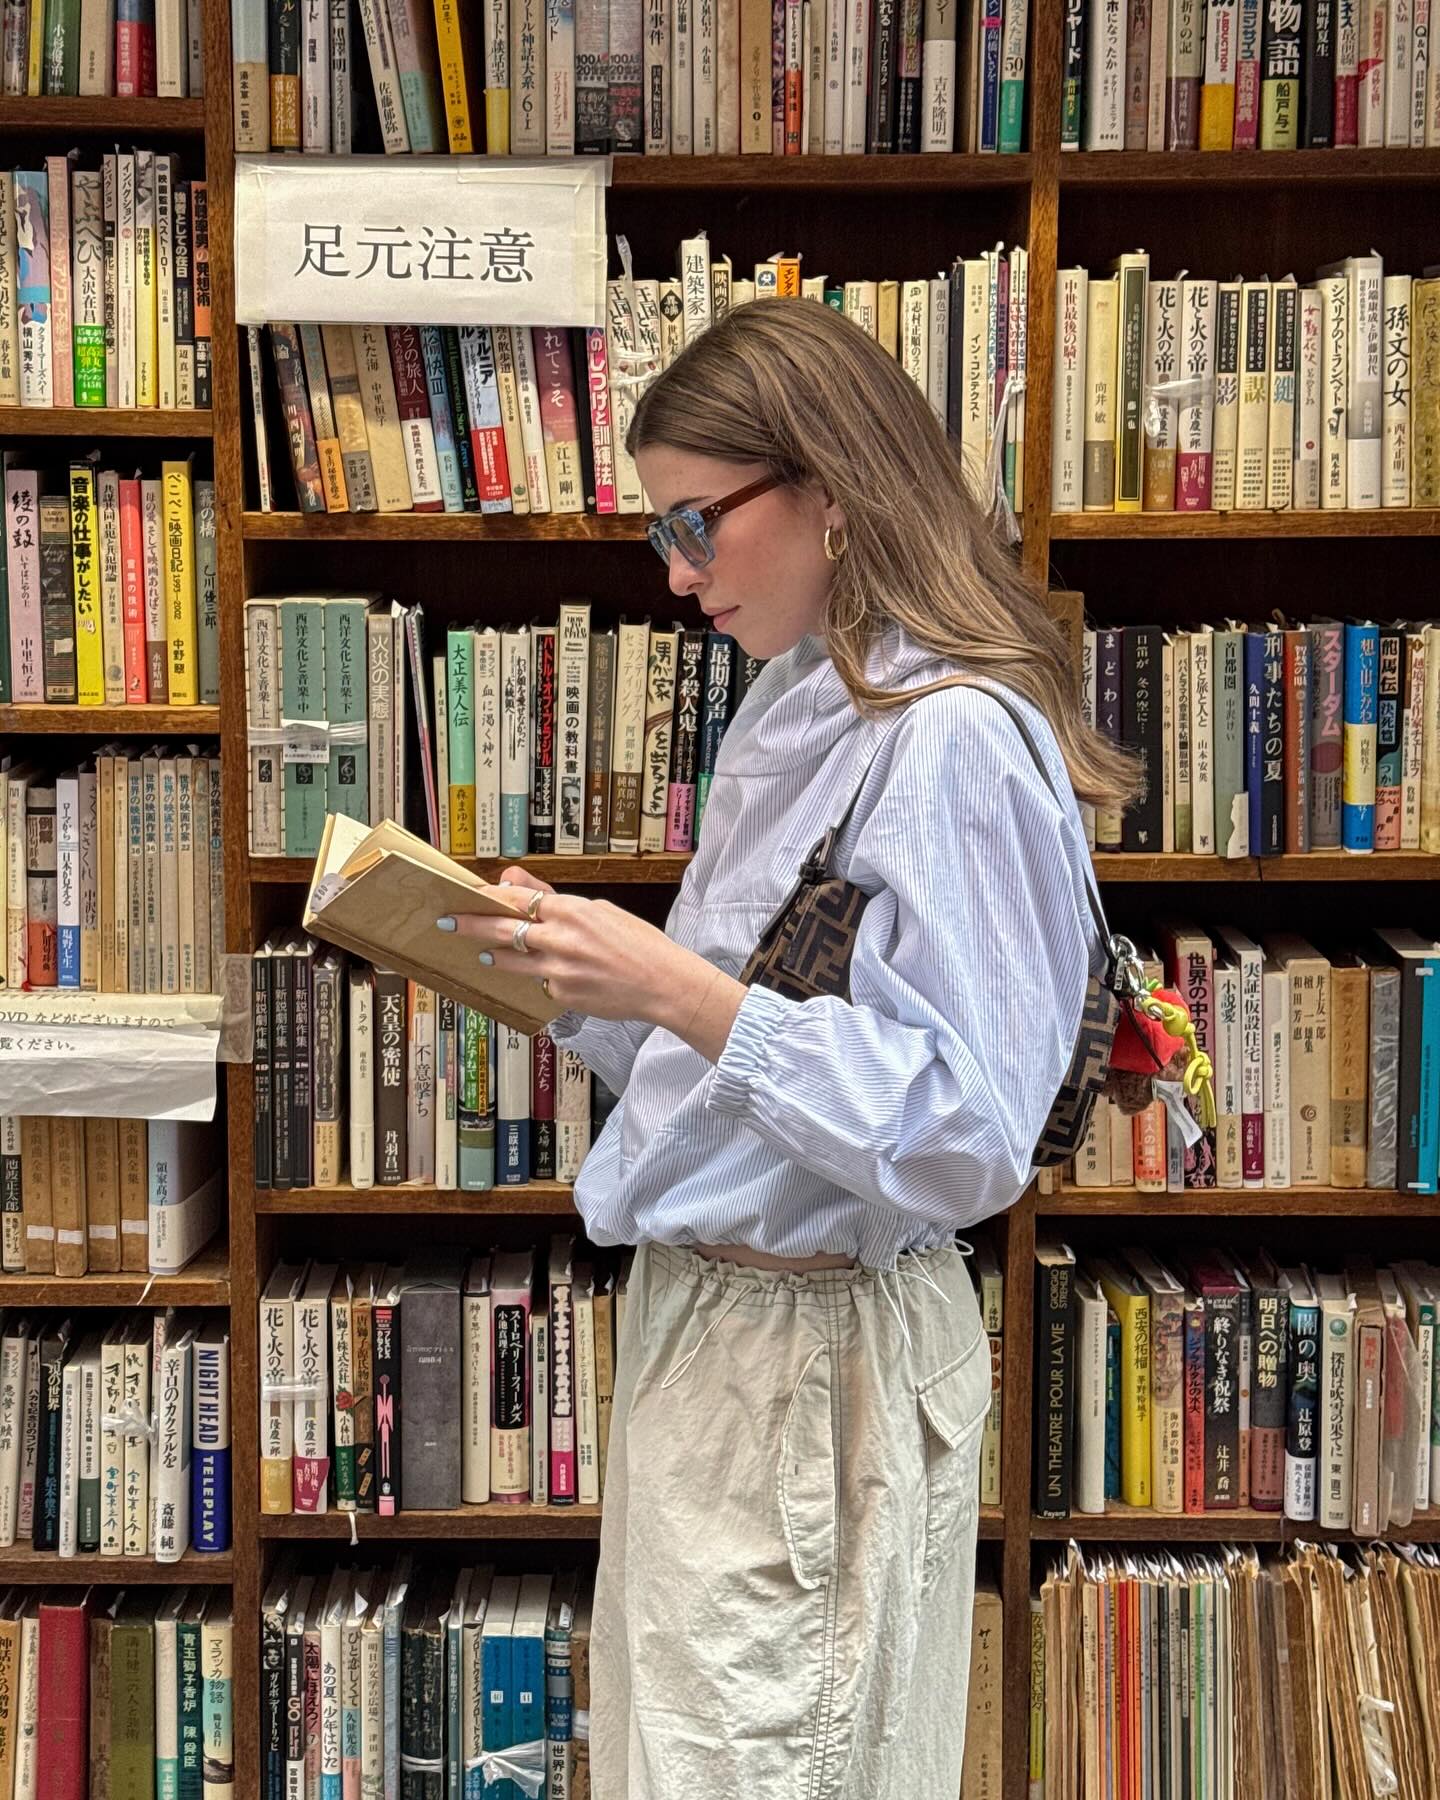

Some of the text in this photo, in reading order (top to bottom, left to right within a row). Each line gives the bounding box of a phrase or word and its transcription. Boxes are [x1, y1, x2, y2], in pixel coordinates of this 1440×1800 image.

[1219, 10, 1230, 72] ABDUCTION
[1268, 0, 1302, 76] 物語
[1315, 3, 1331, 57] 桐野夏生
[932, 77, 947, 137] 吉本隆明
[1275, 83, 1291, 134] 船戸与一
[122, 162, 132, 225] インパクション
[158, 175, 169, 277] 映画監督ベスト101
[294, 223, 535, 283] 足元注意
[686, 254, 705, 314] 建築家
[82, 266, 96, 324] 大沢在昌
[936, 289, 947, 334] 銀色の月
[1064, 279, 1077, 371] 中世最後の騎士
[1155, 286, 1177, 373] 花と火の帝
[1187, 286, 1209, 373] 花と火の帝
[1367, 278, 1379, 376] 川端康成と伊藤初代
[22, 326, 33, 374] 横山秀夫
[37, 326, 46, 396] クライマーズ・ハイ
[545, 326, 564, 408] れてこそ
[970, 333, 981, 421] イン・コンテクスト
[1330, 283, 1345, 406] シベリアのトランペット
[1384, 303, 1410, 407] 孫文の女
[371, 383, 388, 427] 中里恒子
[591, 338, 613, 487] のしつけと訓練法
[1095, 382, 1107, 424] 向井敏
[1216, 377, 1237, 405] 影
[1244, 376, 1266, 404] 謀
[556, 446, 574, 496] 江上剛
[1063, 461, 1073, 493] 江村洋
[1392, 423, 1406, 473] 西木正明
[71, 477, 92, 614] 音楽の仕事がしたい
[102, 484, 117, 582] 共謀共同正犯と共犯理論
[203, 564, 217, 630] 乙川優三郎
[21, 638, 34, 687] 中里恒子
[257, 619, 270, 720] 西洋文化と音楽 上
[295, 613, 310, 714] 西洋文化と音楽 中
[338, 613, 353, 714] 西洋文化と音楽 下
[371, 637, 390, 719] 火災の実態
[451, 643, 470, 727] 大正美人伝
[651, 639, 674, 700] 男が家
[678, 641, 703, 732] 漂う殺人鬼
[706, 642, 731, 725] 最期の声
[1103, 634, 1118, 729] まどわく
[1195, 644, 1209, 728] 舞台と旅と人と
[1223, 641, 1237, 690] 首都圏
[1321, 631, 1343, 737] スターダム
[1381, 639, 1397, 693] 龍馬伝
[481, 685, 495, 768] 血に渇く神々
[542, 635, 553, 766] バトル・オブ・ブラジル
[565, 685, 580, 774] 映画の教科書
[1249, 683, 1260, 733] 久間十義
[1263, 634, 1283, 782] 刑事たちの夏
[1380, 701, 1394, 742] 決死篇
[62, 802, 72, 841] ローマから
[130, 775, 141, 845] 世界の映画作家
[145, 775, 156, 841] 世界の映画作家
[163, 775, 173, 841] 世界の映画作家
[179, 775, 190, 841] 世界の映画作家
[455, 788, 469, 833] 森まゆみ
[62, 853, 73, 907] 日本が見える
[62, 929, 73, 969] 塩野七生
[256, 990, 268, 1049] 新鋭劇作集
[275, 988, 288, 1048] 新鋭劇作集
[295, 988, 309, 1048] 新鋭劇作集
[358, 1000, 369, 1035] トラや
[381, 993, 401, 1087] 天皇の密使
[1243, 963, 1261, 1063] 実証・仮設住宅
[414, 1044, 432, 1118] 不意撃ち
[5, 1160, 20, 1212] 池波正太郎
[384, 1130, 399, 1173] 丹羽昌一
[1049, 1268, 1060, 1310] GIORGIO
[1058, 1270, 1069, 1310] STREHLER
[264, 1308, 284, 1387] 花と火の帝
[300, 1308, 321, 1387] 花と火の帝
[335, 1308, 350, 1385] 唐獅子株式会社
[497, 1309, 508, 1359] 小池真理子
[509, 1309, 524, 1425] ストロベリー・フィールズ
[1213, 1316, 1232, 1414] 終りなき祝祭
[1257, 1297, 1279, 1389] 明日への贈物
[1295, 1312, 1317, 1383] 闇の奥
[162, 1359, 180, 1469] 辛口のカクテルを
[199, 1350, 219, 1444] NIGHT HEAD
[1047, 1322, 1067, 1497] UN THEATRE POUR LA VIE
[1297, 1408, 1314, 1450] 辻原登
[1329, 1351, 1345, 1457] 探偵は吹雪の果てに
[202, 1455, 215, 1543] TELEPLAY
[1216, 1444, 1230, 1491] 辻井喬
[1330, 1463, 1342, 1501] 東直己
[183, 1634, 197, 1712] 青玉獅子香炉
[208, 1639, 225, 1705] マラッカ物語
[322, 1662, 338, 1768] あの夏、少年はいた
[552, 1745, 566, 1799] 世界の映
